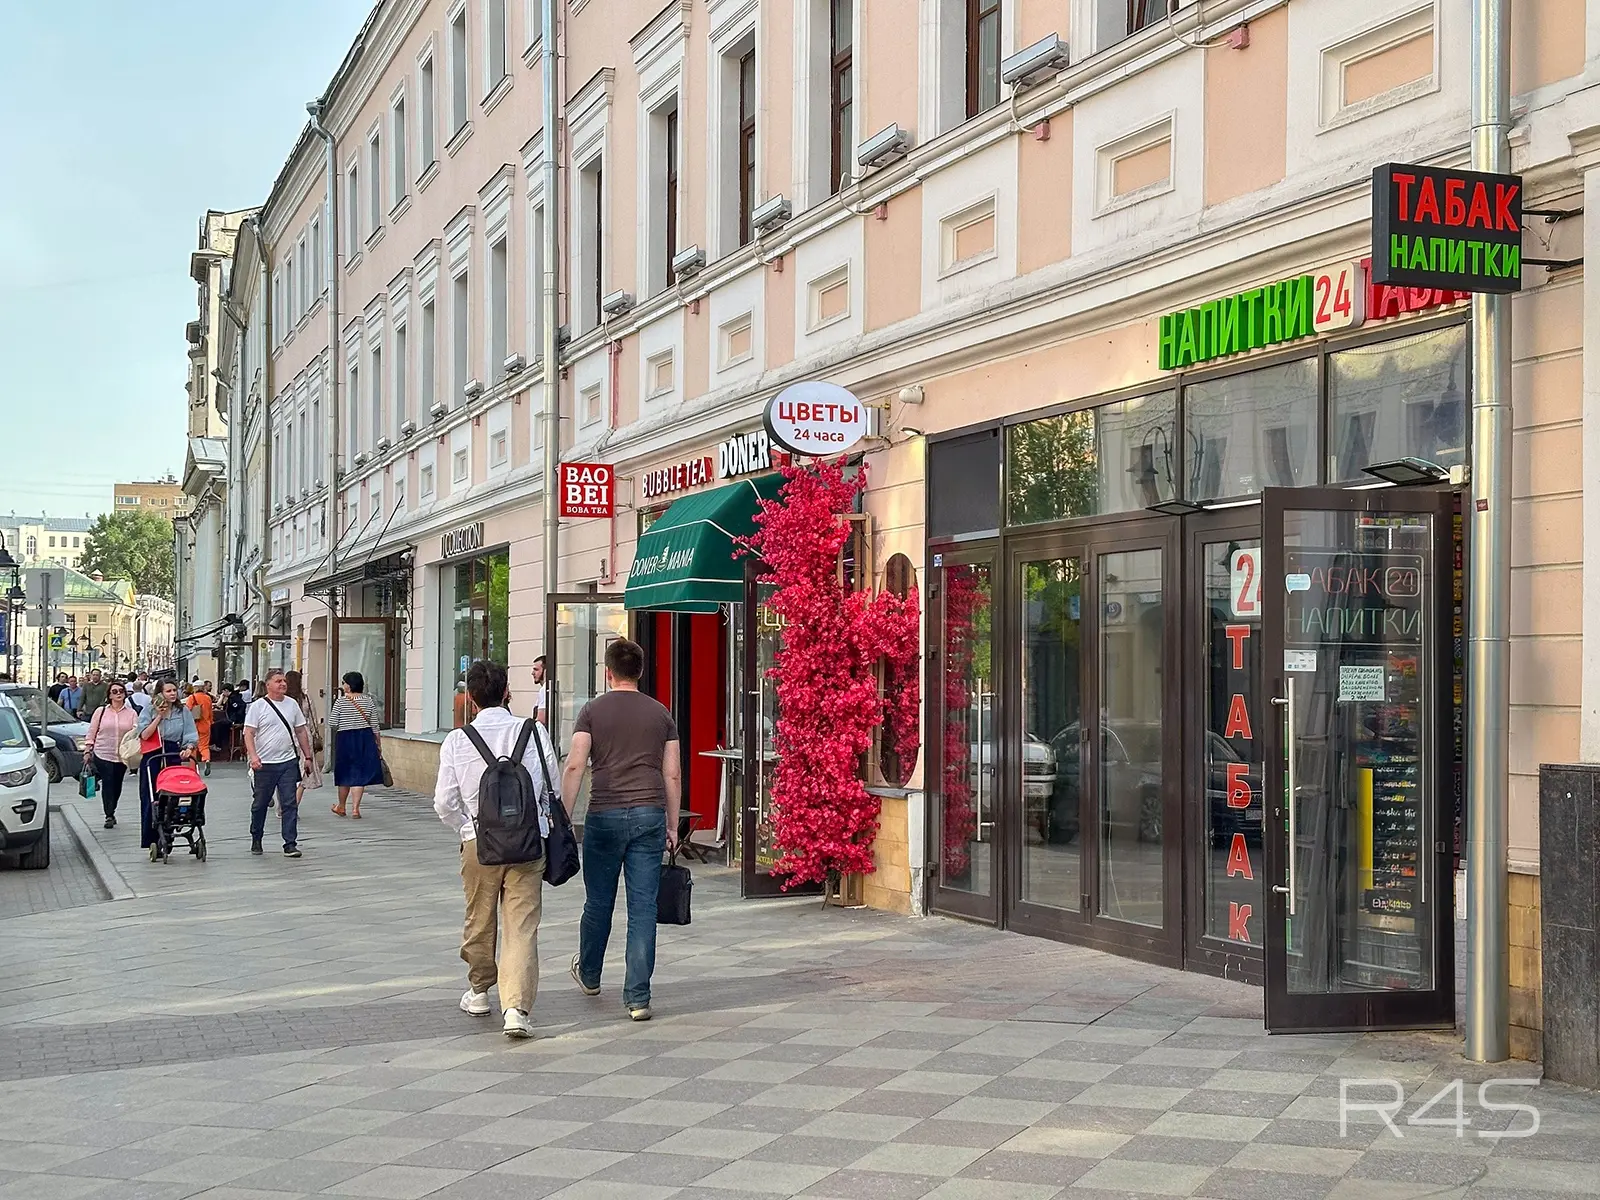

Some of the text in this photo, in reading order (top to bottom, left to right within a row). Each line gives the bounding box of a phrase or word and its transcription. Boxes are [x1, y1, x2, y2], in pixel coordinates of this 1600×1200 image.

[1392, 172, 1520, 232] ТАБАК
[1390, 233, 1520, 279] НАПИТКИ
[1159, 275, 1314, 369] НАПИТКИ
[1314, 270, 1352, 325] 24
[778, 401, 859, 425] ЦВЕТЫ
[793, 428, 845, 442] 24 часа
[565, 466, 609, 484] BAO
[642, 456, 712, 498] BUBBLE TEA
[565, 484, 609, 505] BEI
[566, 506, 590, 514] BOBA
[630, 547, 695, 578] DONER MANIA
[1236, 553, 1262, 612] 2
[1388, 570, 1416, 594] 24
[1286, 606, 1421, 636] НАПИТКИ
[1224, 624, 1254, 943] ТАБАК
